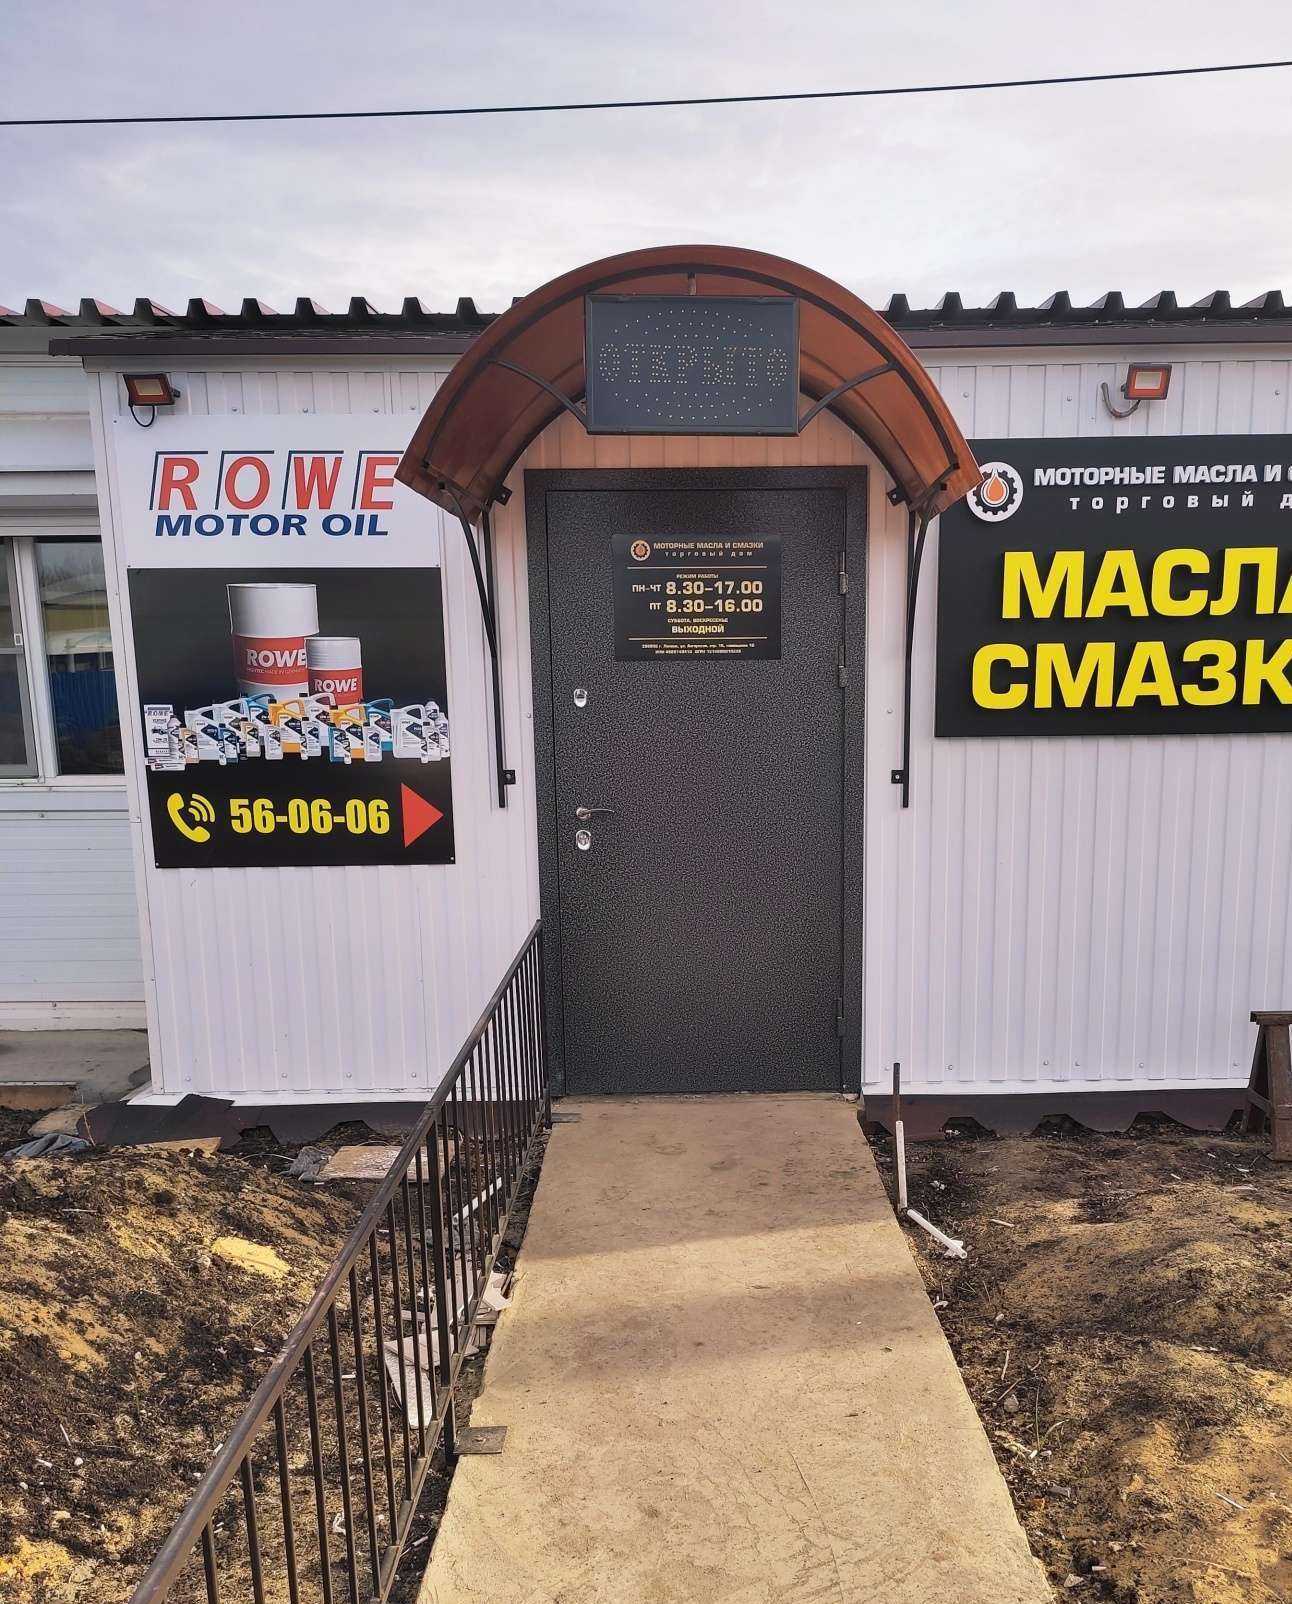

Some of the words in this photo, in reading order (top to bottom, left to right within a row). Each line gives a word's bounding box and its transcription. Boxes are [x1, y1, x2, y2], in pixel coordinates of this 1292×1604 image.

[150, 451, 402, 510] ROWE
[1033, 466, 1166, 486] МОТОРНЫЕ
[1173, 465, 1258, 484] МАСЛА
[1264, 464, 1282, 483] И
[1069, 490, 1255, 514] торговый
[155, 514, 307, 537] MOTOR
[321, 514, 389, 536] OIL
[653, 542, 695, 550] МОТОРНЫЕ
[1002, 547, 1292, 619] МАСЛ
[649, 602, 662, 610] ПТ
[671, 624, 725, 635] ВЫХОДНОЙ
[246, 648, 306, 668] ROWE
[314, 678, 358, 692] ROWE
[229, 798, 391, 834] 56-06-06
